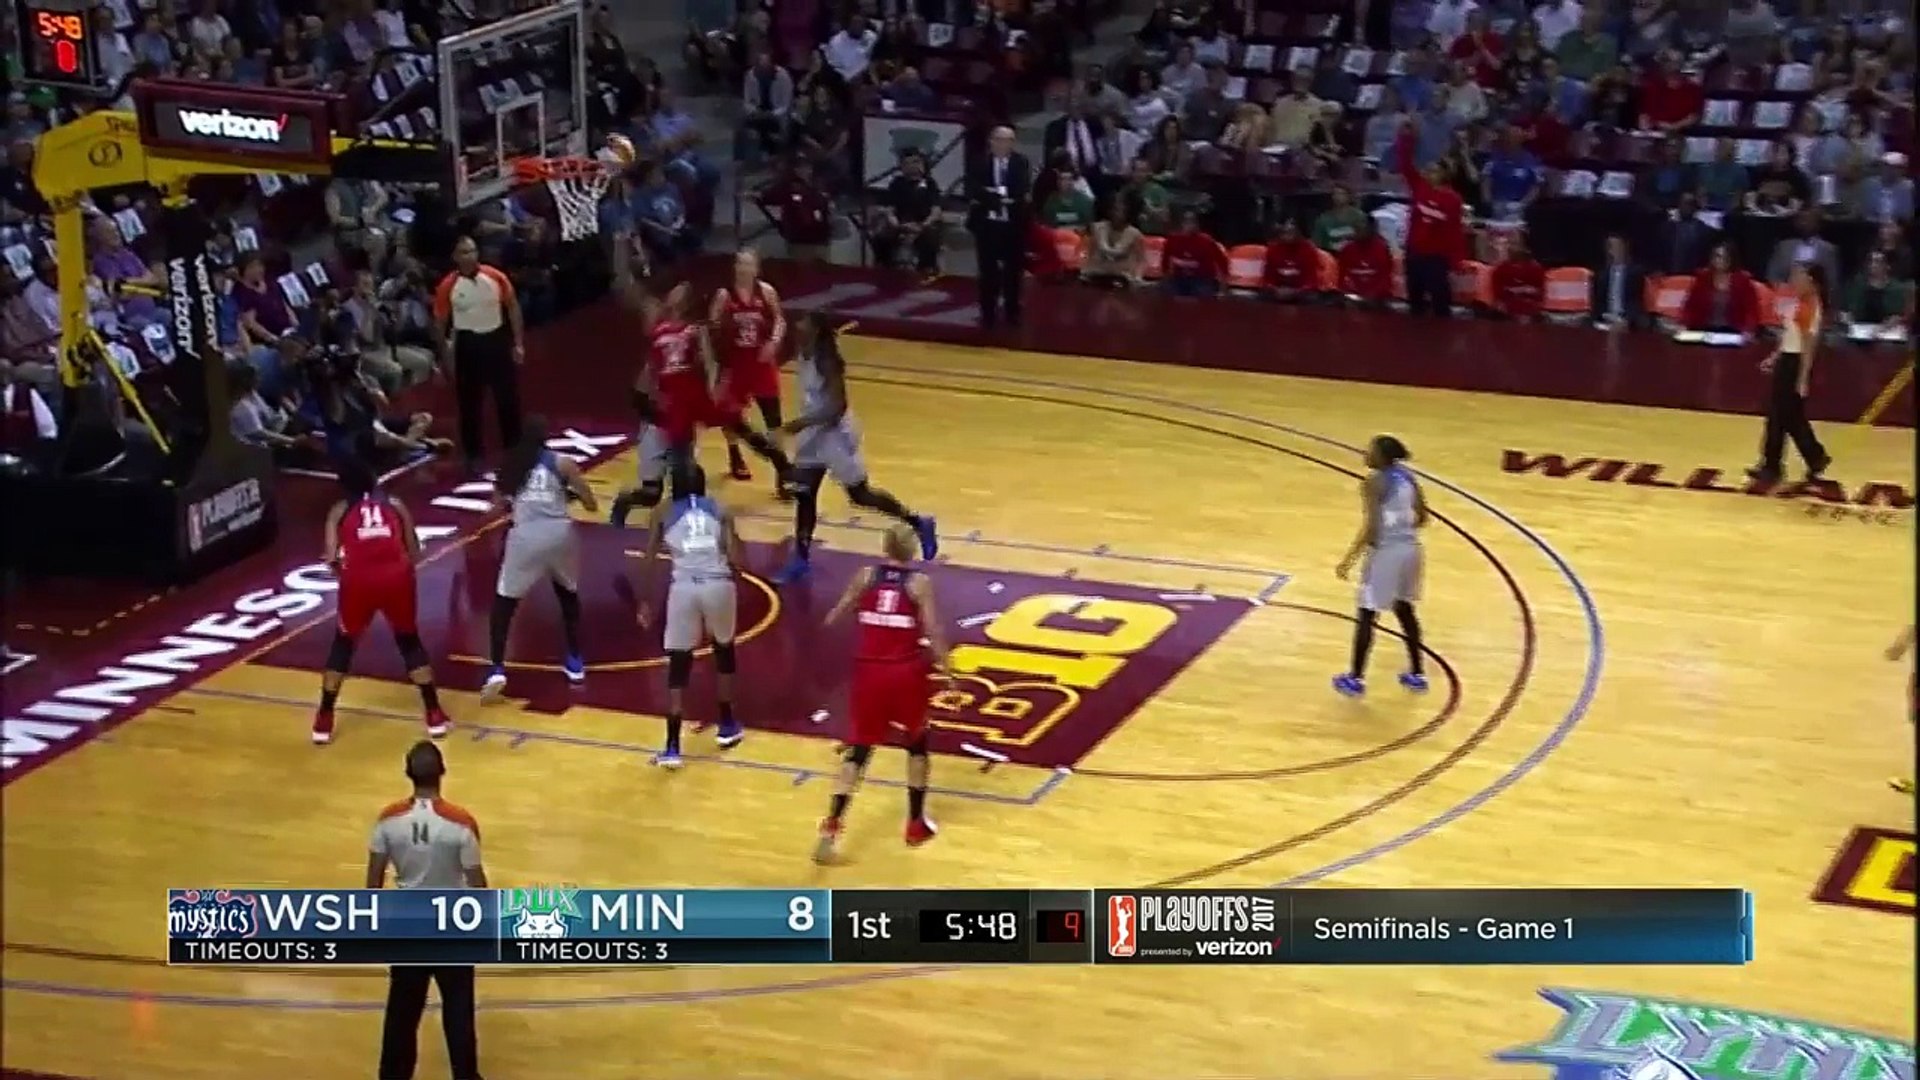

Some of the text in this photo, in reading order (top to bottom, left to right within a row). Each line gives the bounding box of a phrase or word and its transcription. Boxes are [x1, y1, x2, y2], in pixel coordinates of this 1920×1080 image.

[178, 108, 280, 142] verizon
[169, 257, 194, 349] verizon
[412, 821, 429, 846] 14
